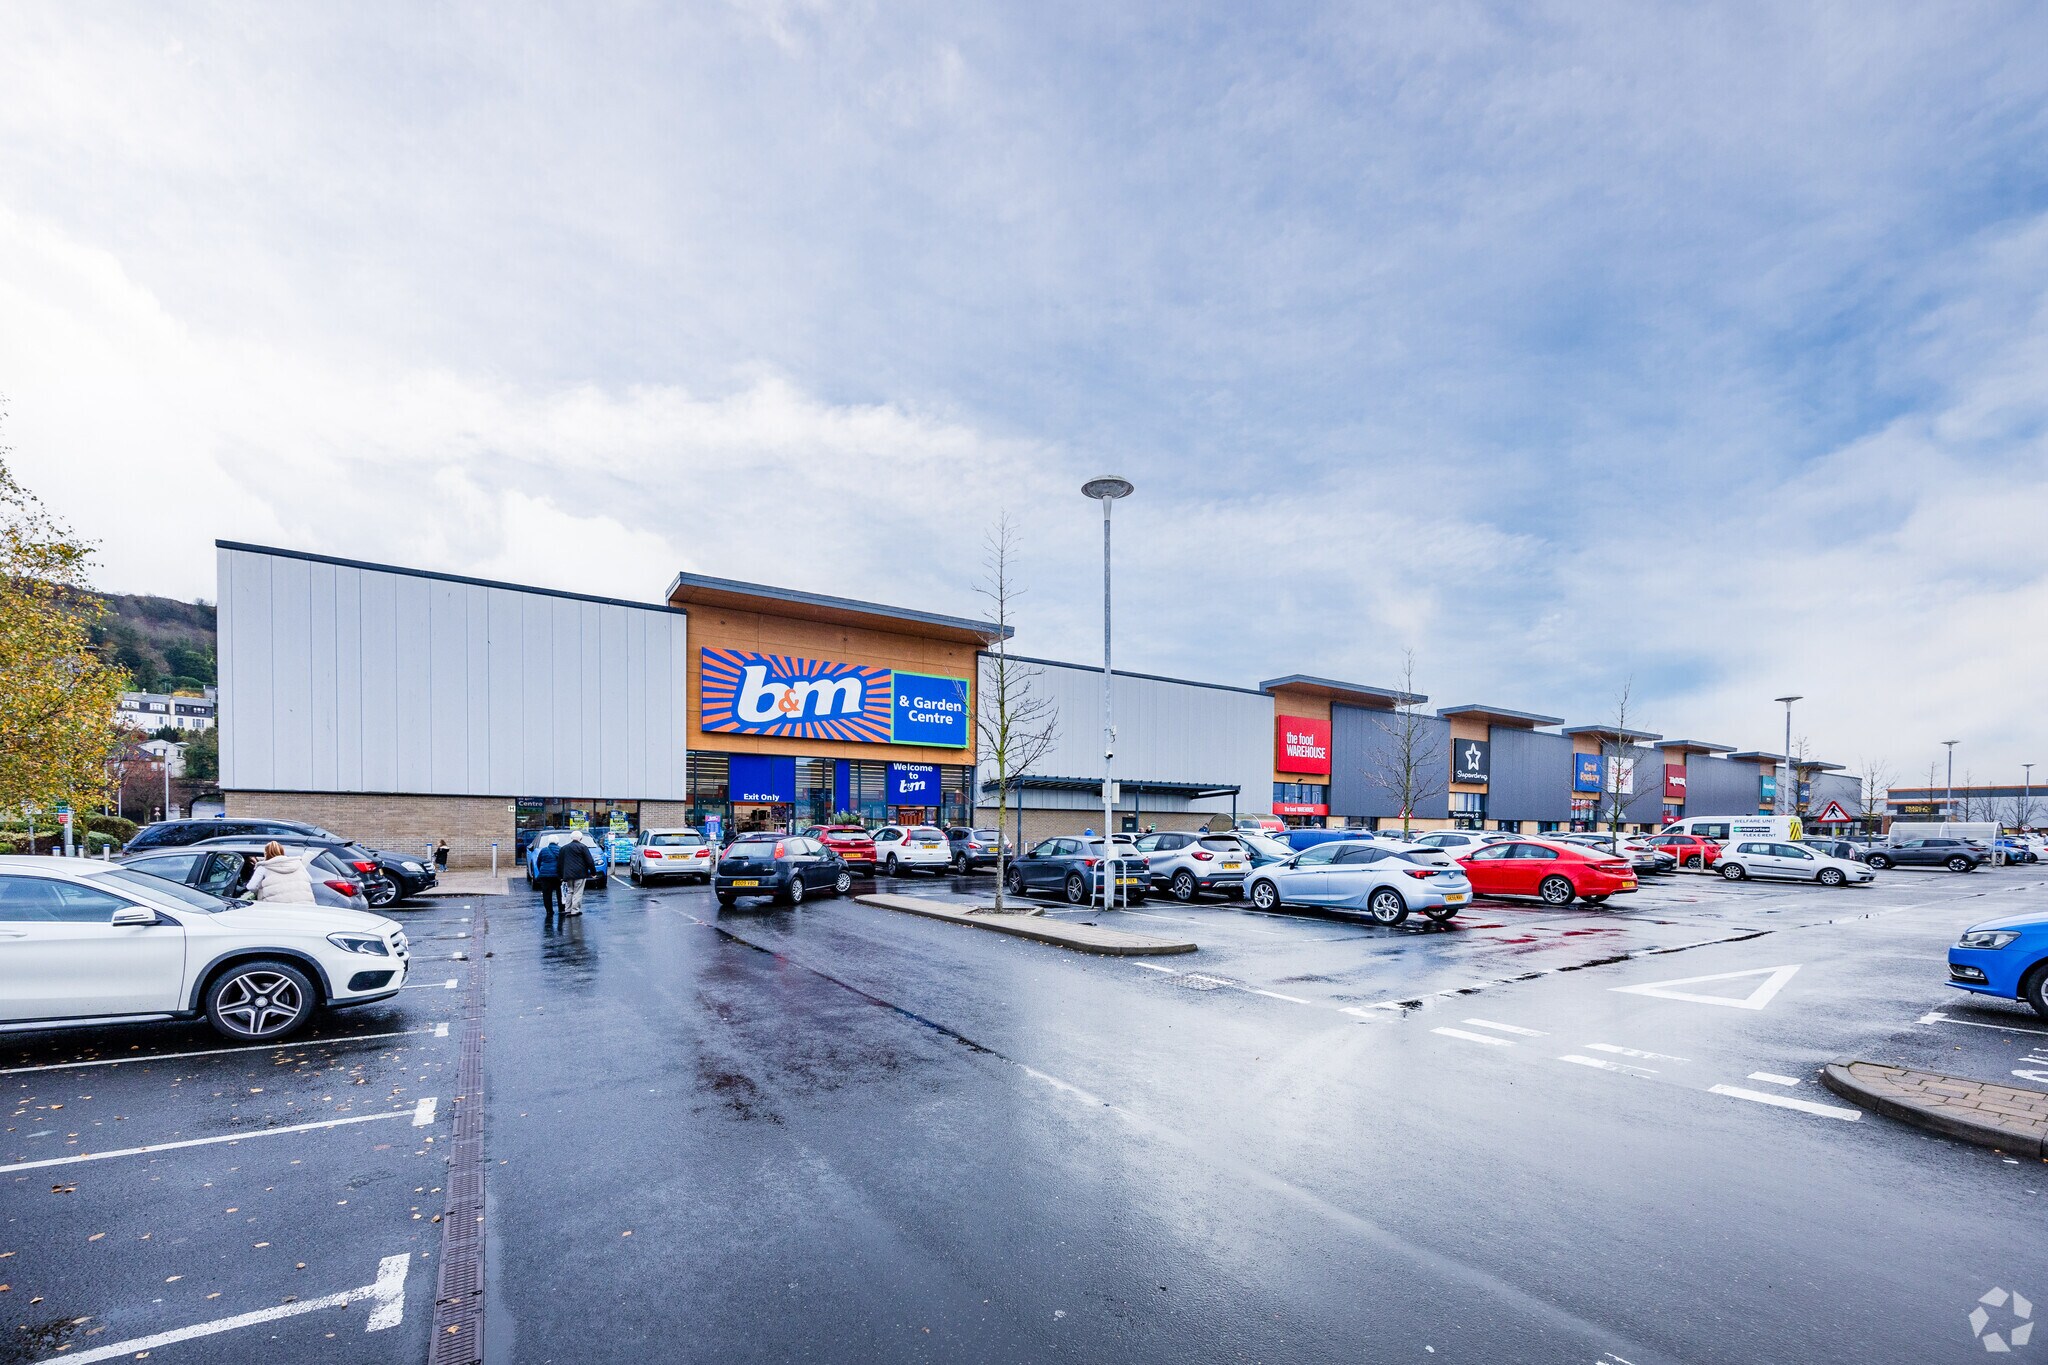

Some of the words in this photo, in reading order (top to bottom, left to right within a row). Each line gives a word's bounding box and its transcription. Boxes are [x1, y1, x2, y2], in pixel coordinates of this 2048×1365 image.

[899, 695, 910, 707] &
[913, 697, 962, 712] Garden
[908, 710, 953, 725] Centre
[1286, 732, 1298, 744] the
[1299, 733, 1314, 745] food
[1286, 745, 1326, 759] WAREHOUSE
[893, 763, 934, 772] Welcome
[909, 772, 919, 780] to
[1457, 770, 1488, 781] Superdrug
[743, 793, 760, 801] Exit
[761, 794, 780, 802] Only
